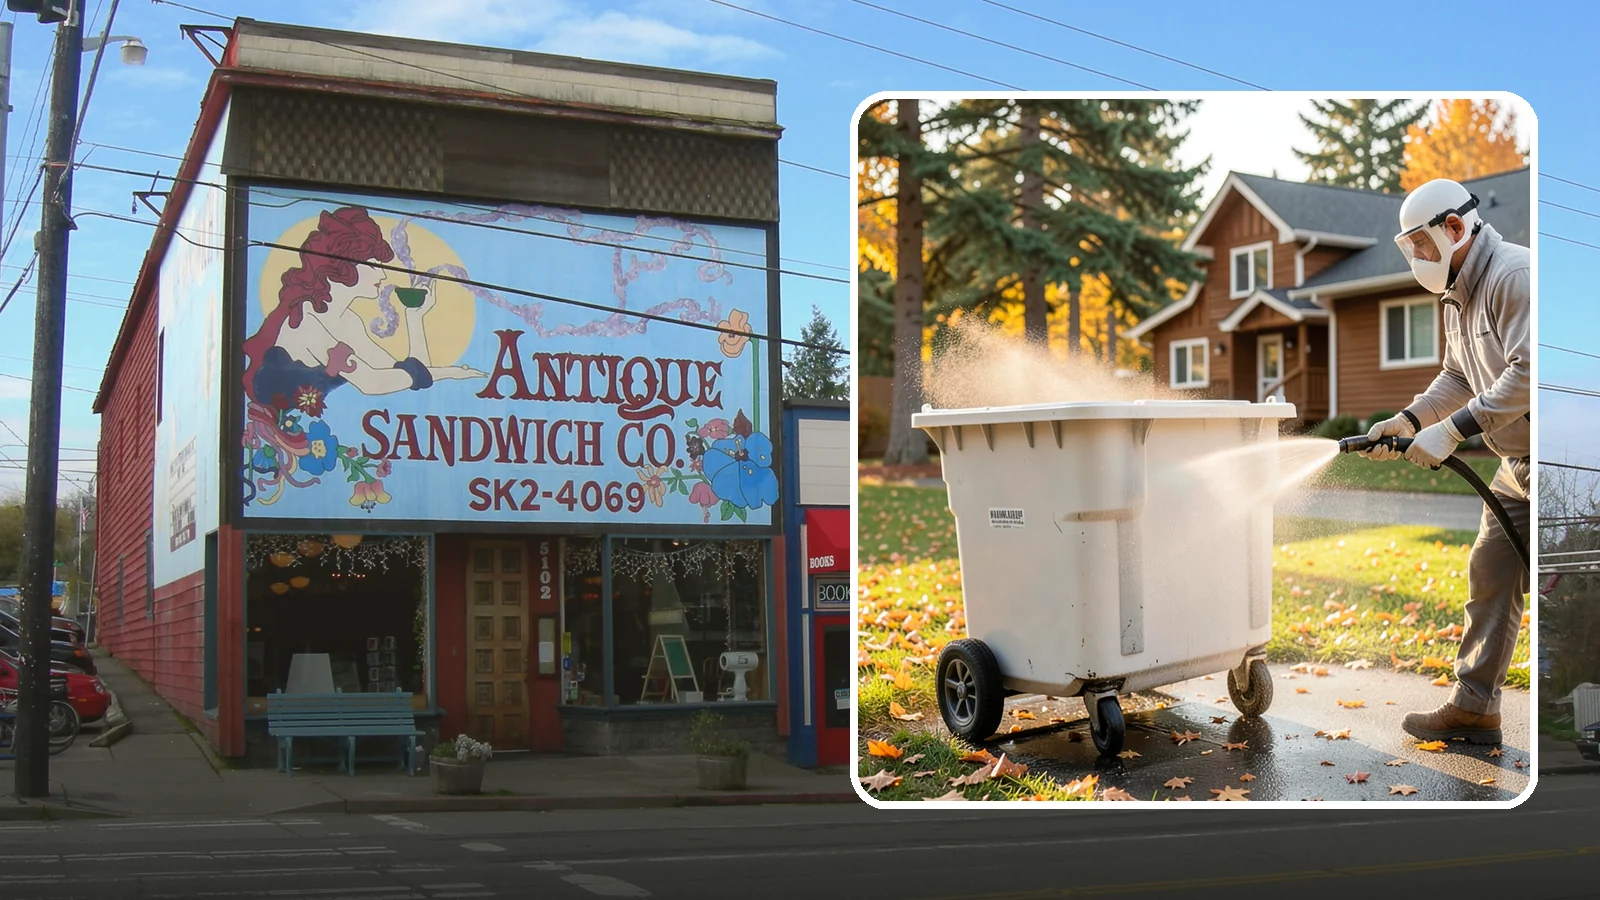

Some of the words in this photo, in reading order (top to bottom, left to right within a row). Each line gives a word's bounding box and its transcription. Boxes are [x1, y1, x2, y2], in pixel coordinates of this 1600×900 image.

[476, 328, 723, 420] ANTIQUE
[361, 408, 604, 467] SANDWICH
[617, 422, 685, 469] CO.
[468, 477, 646, 513] SK2-4069
[540, 542, 551, 599] 5102
[809, 555, 834, 568] BOOKS
